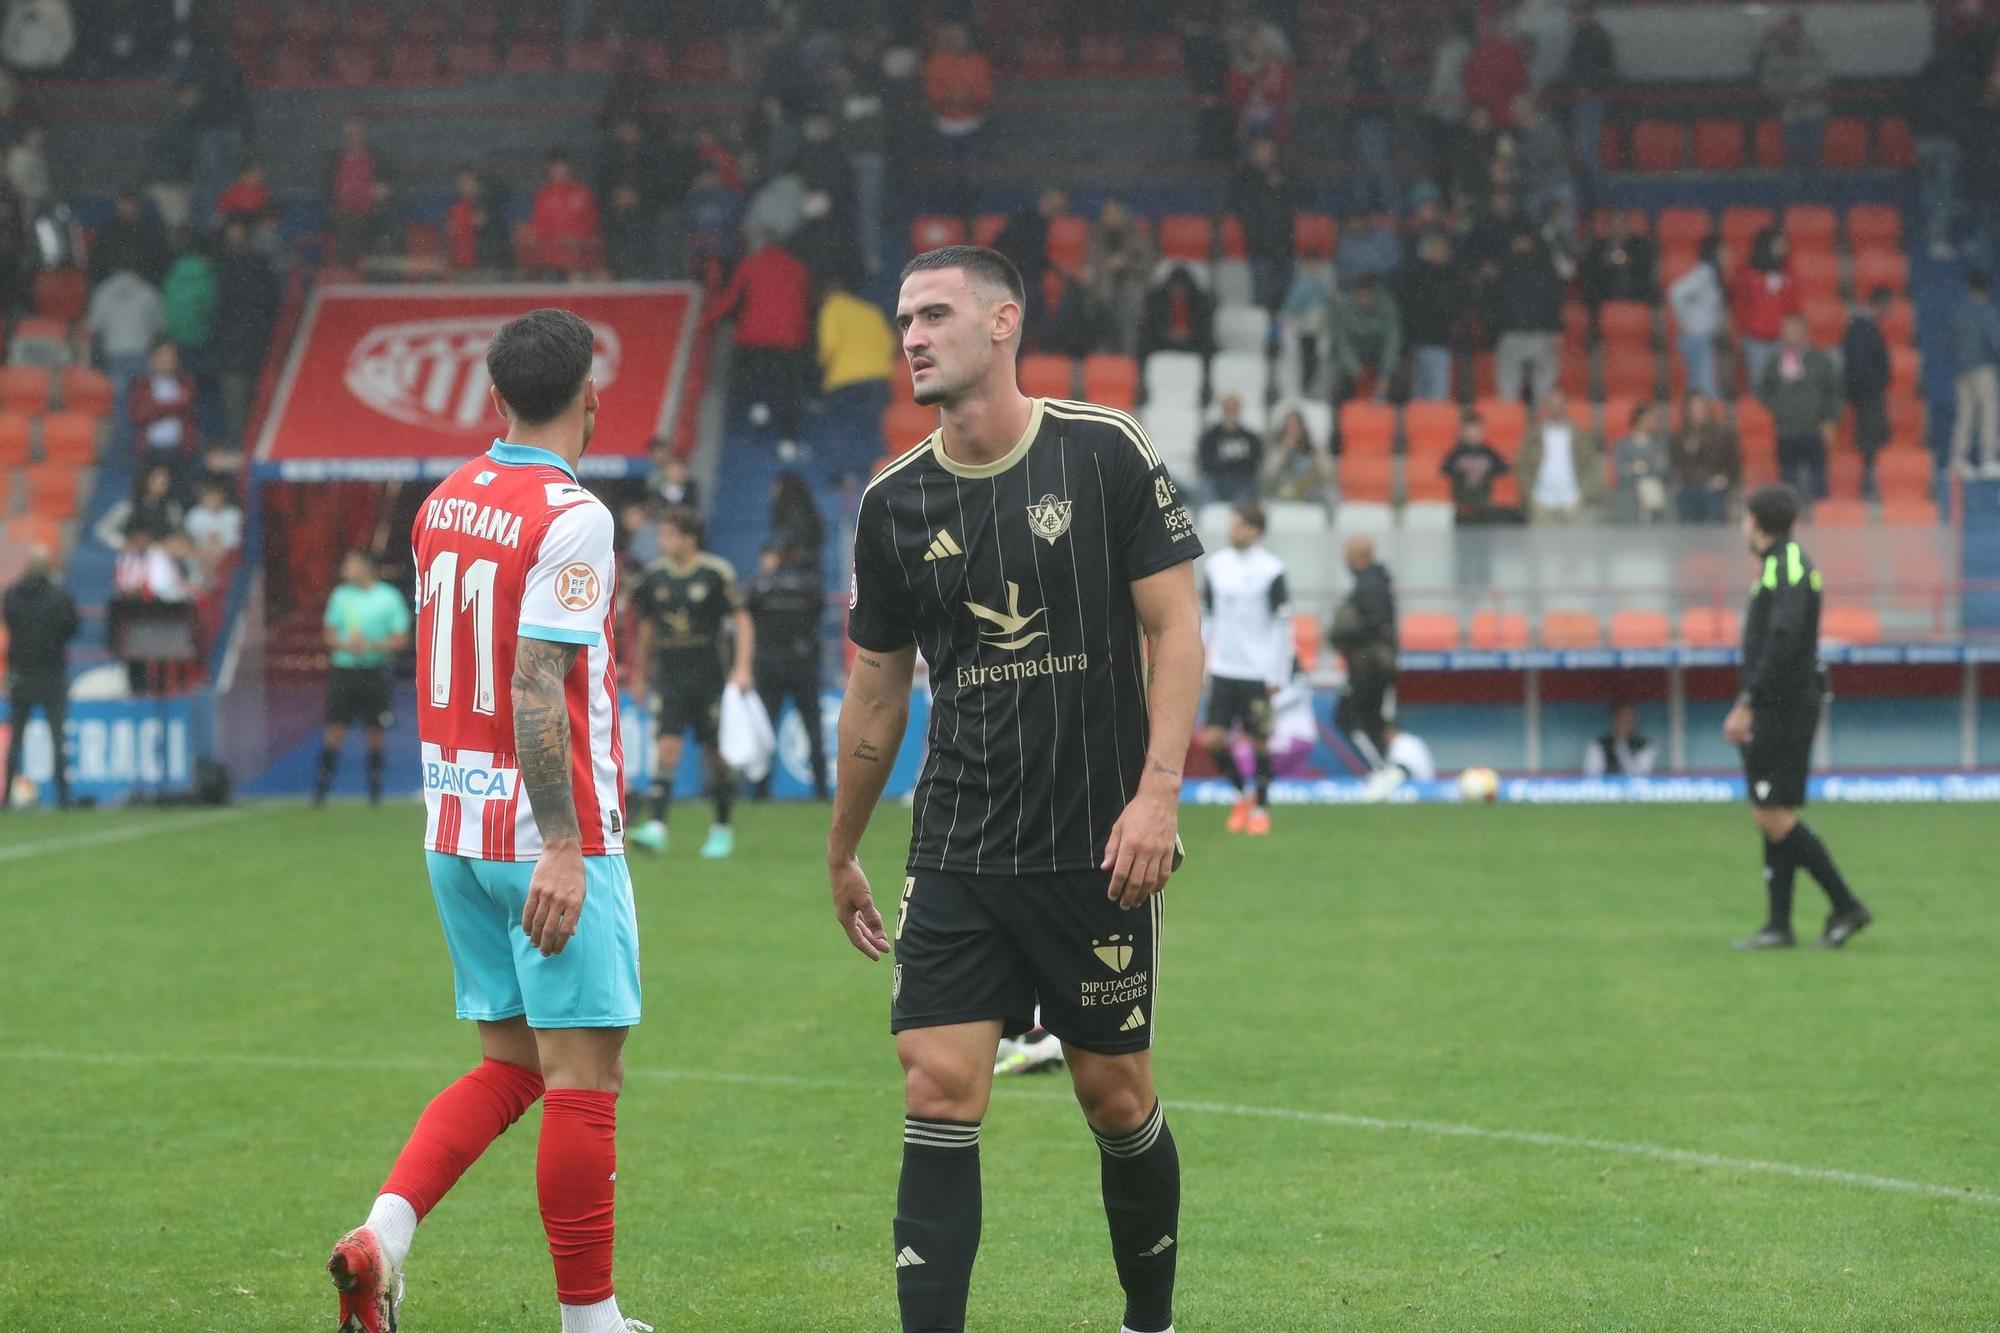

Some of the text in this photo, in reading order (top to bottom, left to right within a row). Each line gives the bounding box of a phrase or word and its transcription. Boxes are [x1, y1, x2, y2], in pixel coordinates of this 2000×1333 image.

[422, 550, 499, 717] 11
[956, 651, 1089, 688] Extremadura
[1081, 970, 1147, 993] DIPUTACIÓN
[1081, 984, 1148, 1006] DE CÁCERES
